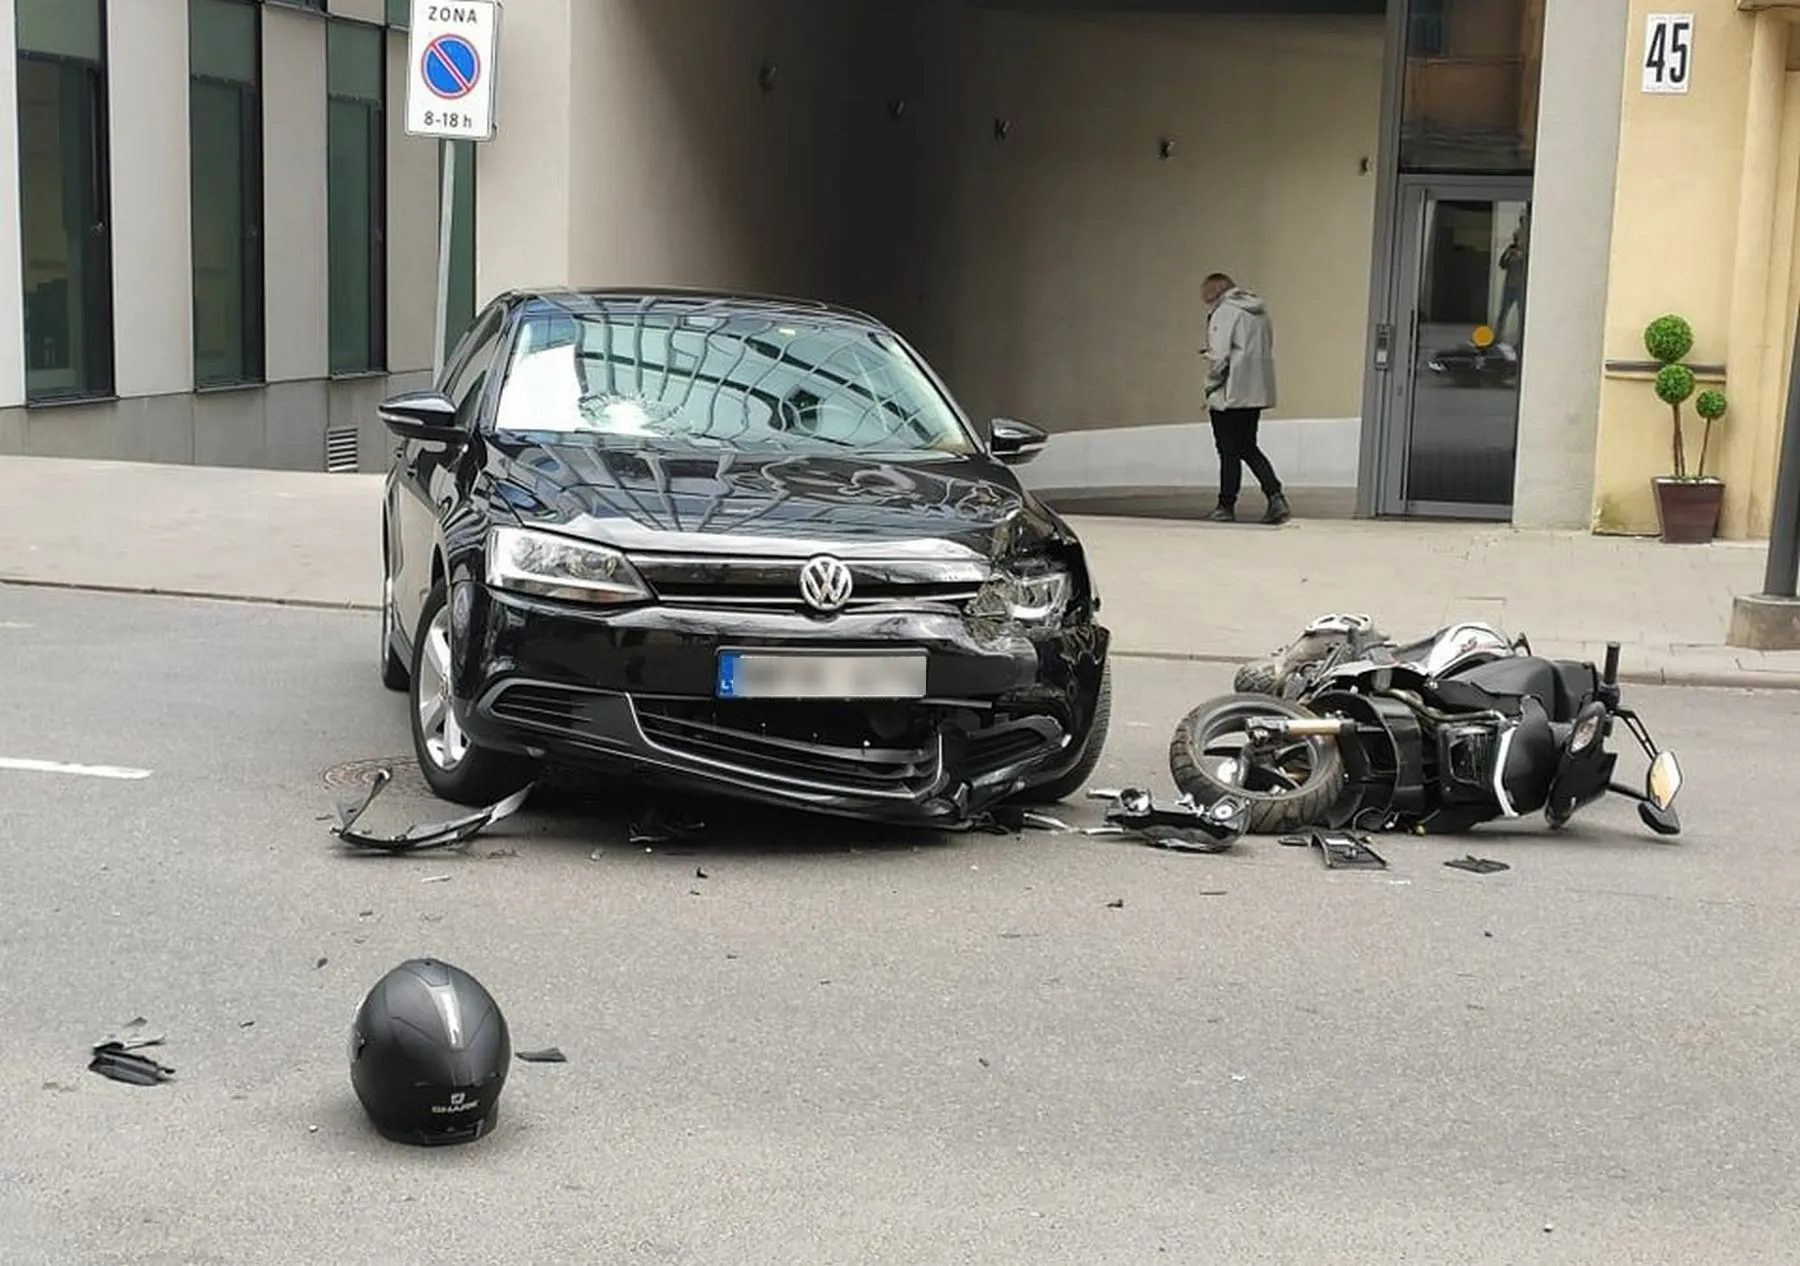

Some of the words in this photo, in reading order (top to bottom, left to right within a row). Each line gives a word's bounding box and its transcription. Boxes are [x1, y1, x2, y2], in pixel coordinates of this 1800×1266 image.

[428, 6, 477, 23] ZONA
[1645, 23, 1689, 83] 45
[424, 111, 458, 127] 8-18
[463, 115, 472, 128] h
